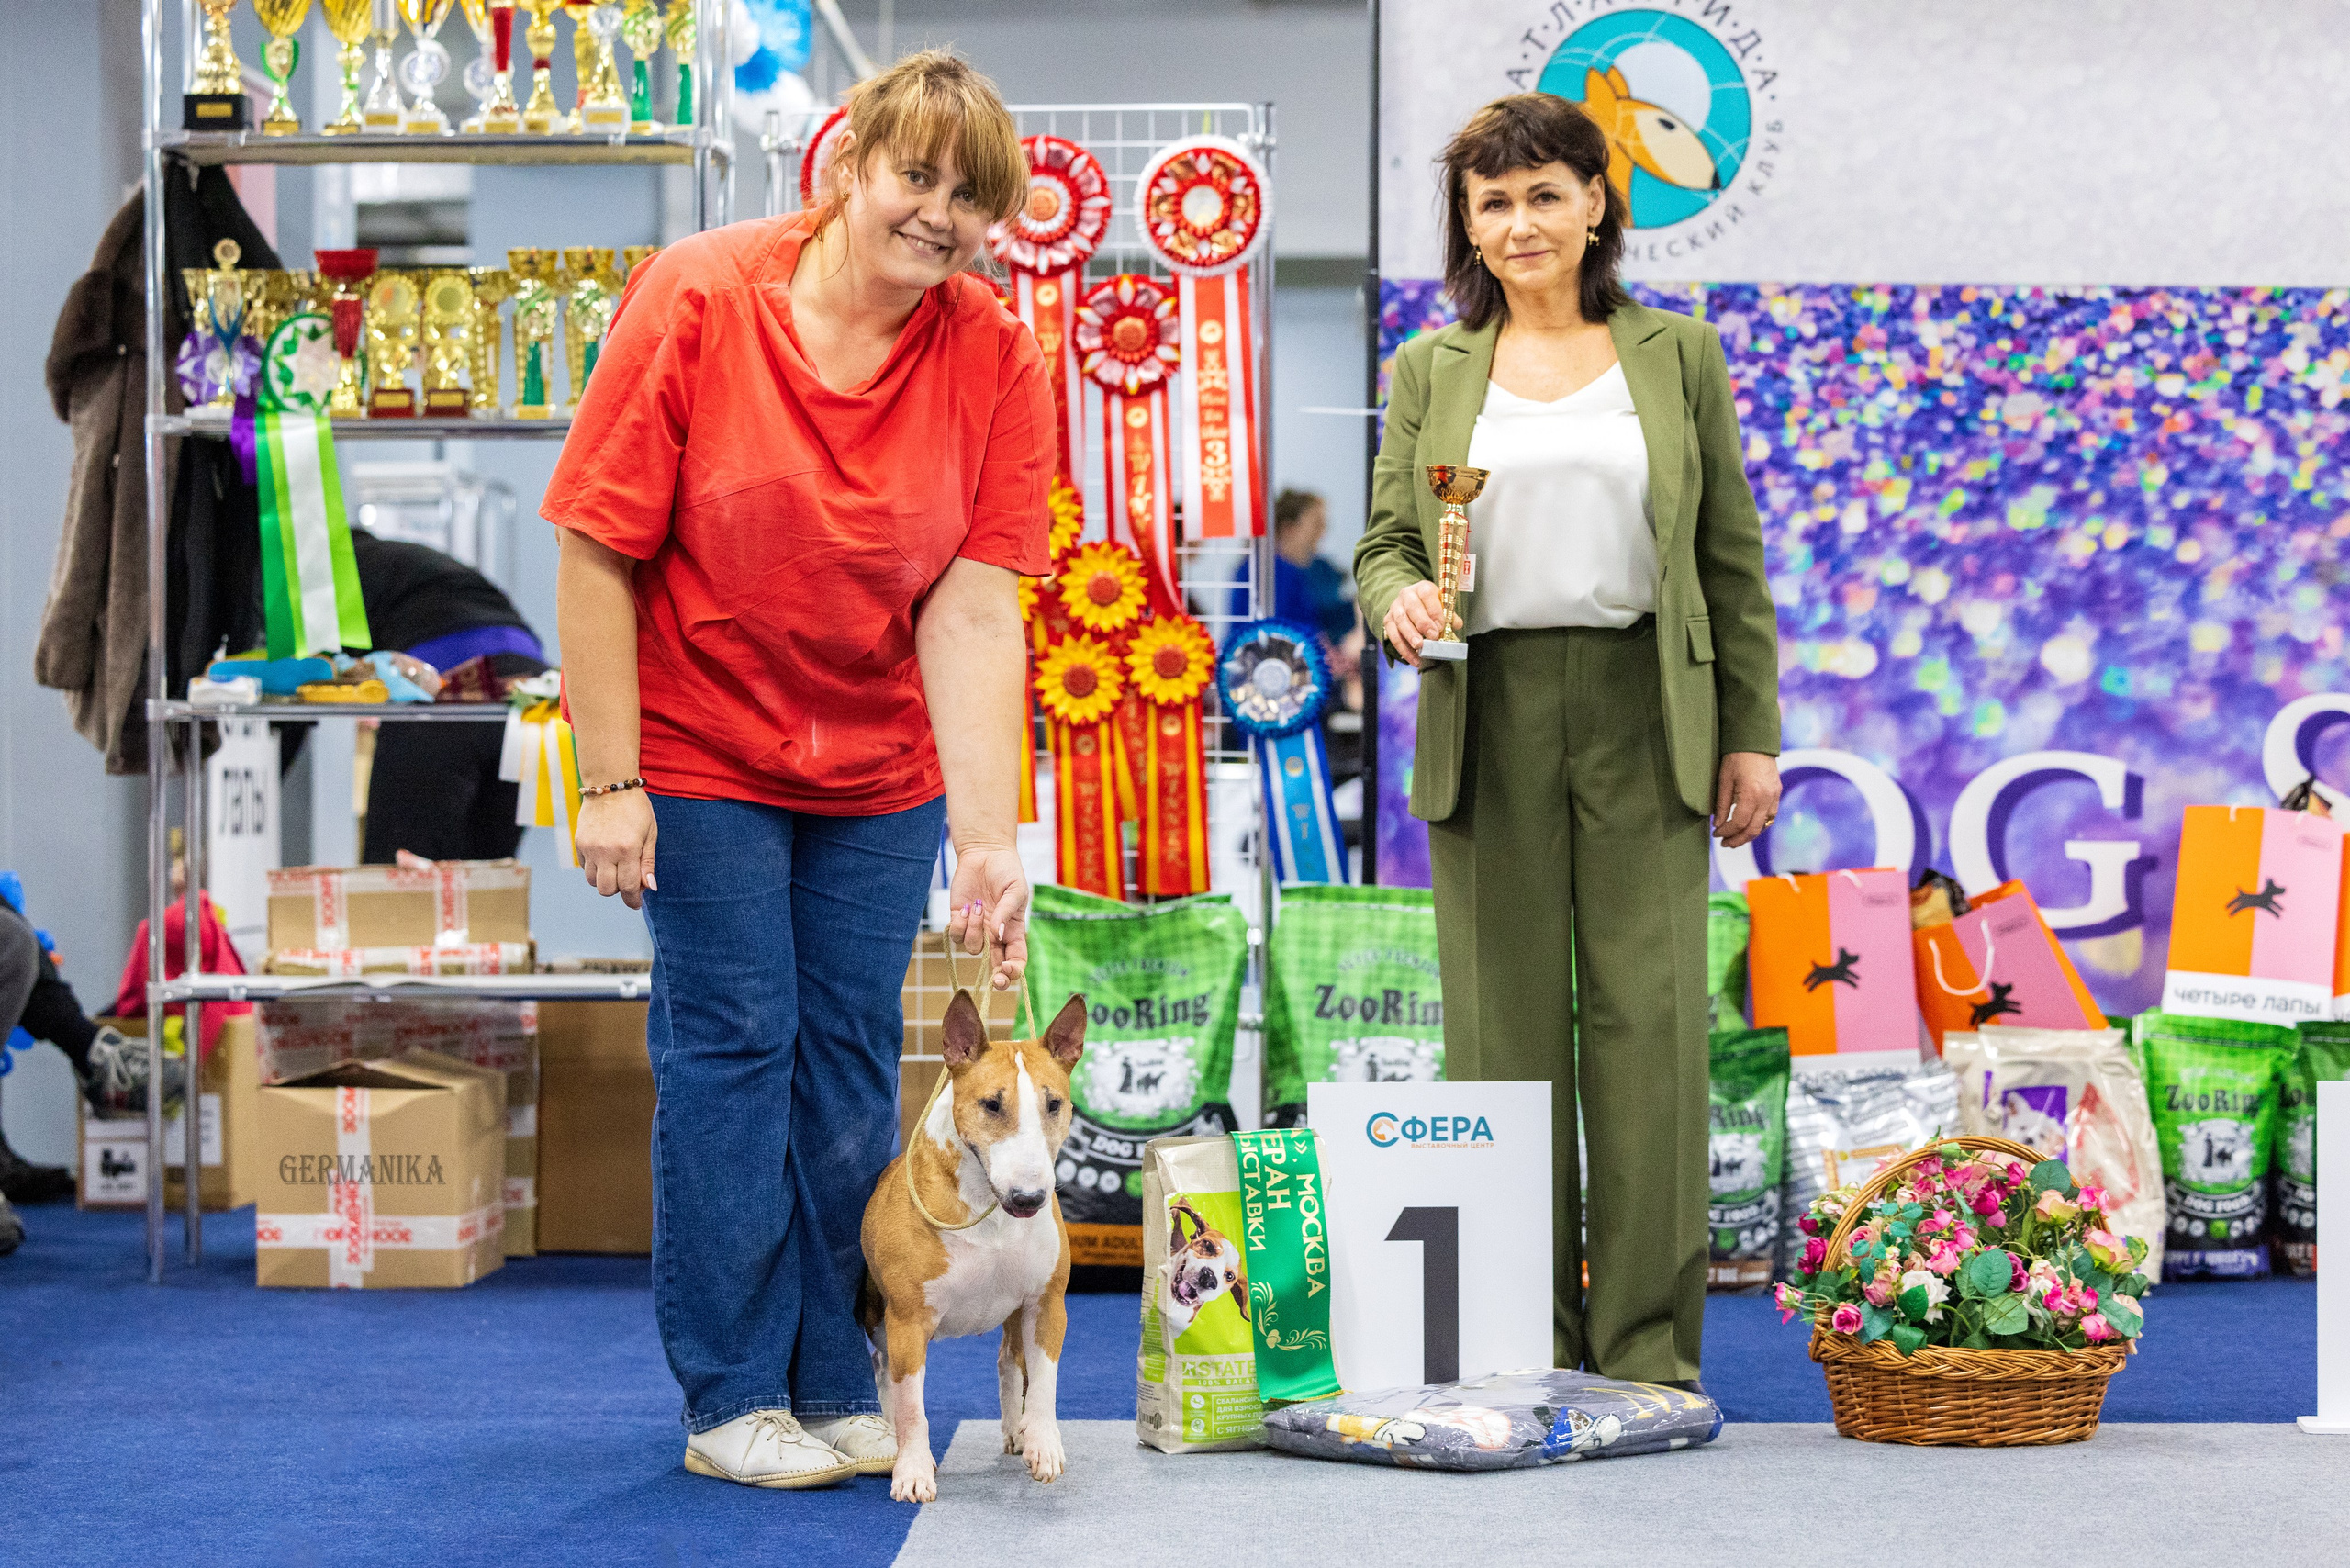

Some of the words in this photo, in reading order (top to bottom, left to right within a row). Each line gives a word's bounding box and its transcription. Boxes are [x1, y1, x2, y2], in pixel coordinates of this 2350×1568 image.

[1626, 203, 1744, 262] ЧЕСКИЙ
[1746, 118, 1785, 196] КЛУБ
[1204, 440, 1228, 468] 3
[1711, 747, 2141, 929] OG
[1069, 984, 1218, 1031] ooRing
[1315, 984, 1444, 1026] ZooRin
[2173, 986, 2257, 1011] четыре
[2261, 994, 2322, 1015] лапы
[1366, 1112, 1494, 1148] СФЕРА
[1709, 1101, 1771, 1133] Ring
[1410, 1141, 1469, 1149] ВЫСТАВОЧНЫЙ
[1259, 1129, 1292, 1211] ЕРАН
[1239, 1132, 1268, 1252] ЫСТАВКИ
[1295, 1173, 1326, 1299] МОСКВА
[1384, 1206, 1460, 1386] 1
[1197, 1361, 1257, 1378] STATE
[1216, 1395, 1262, 1406] СБАЛАНСИРО
[1216, 1413, 1251, 1422] КРУПНЫХ
[1235, 1404, 1263, 1413] ВЗРОСЛ
[1216, 1427, 1225, 1435] С
